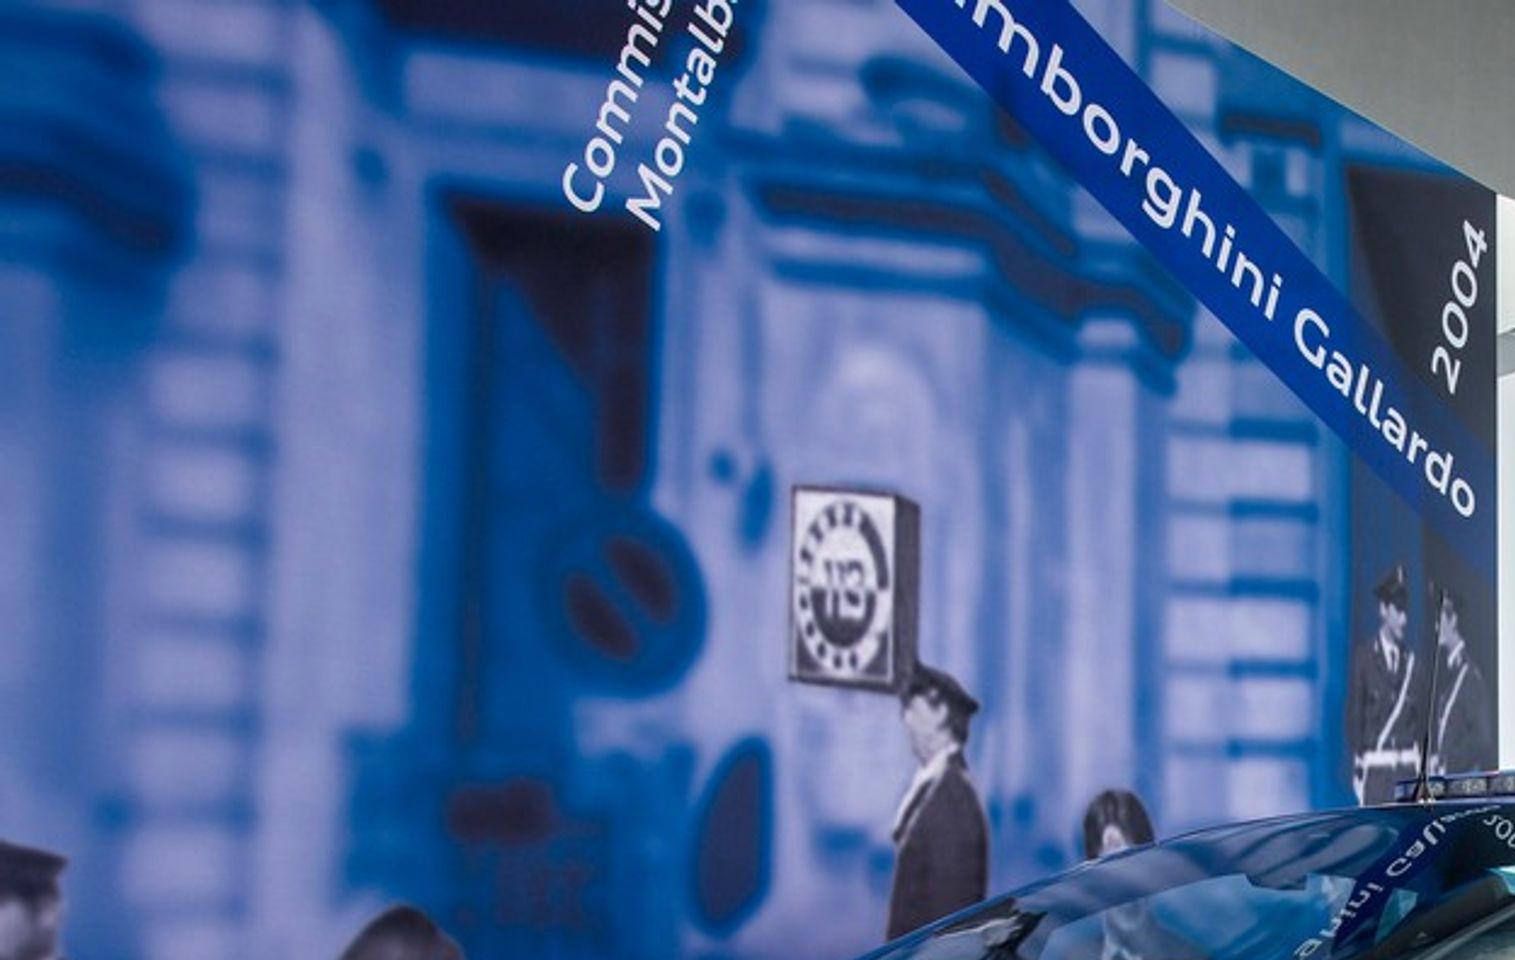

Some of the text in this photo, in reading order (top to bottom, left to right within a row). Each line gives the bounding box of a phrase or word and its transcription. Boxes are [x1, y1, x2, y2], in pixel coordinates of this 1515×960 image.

[625, 0, 738, 231] Montalb
[955, 0, 1476, 518] mborghini Gallardo
[1411, 220, 1488, 394] 2004
